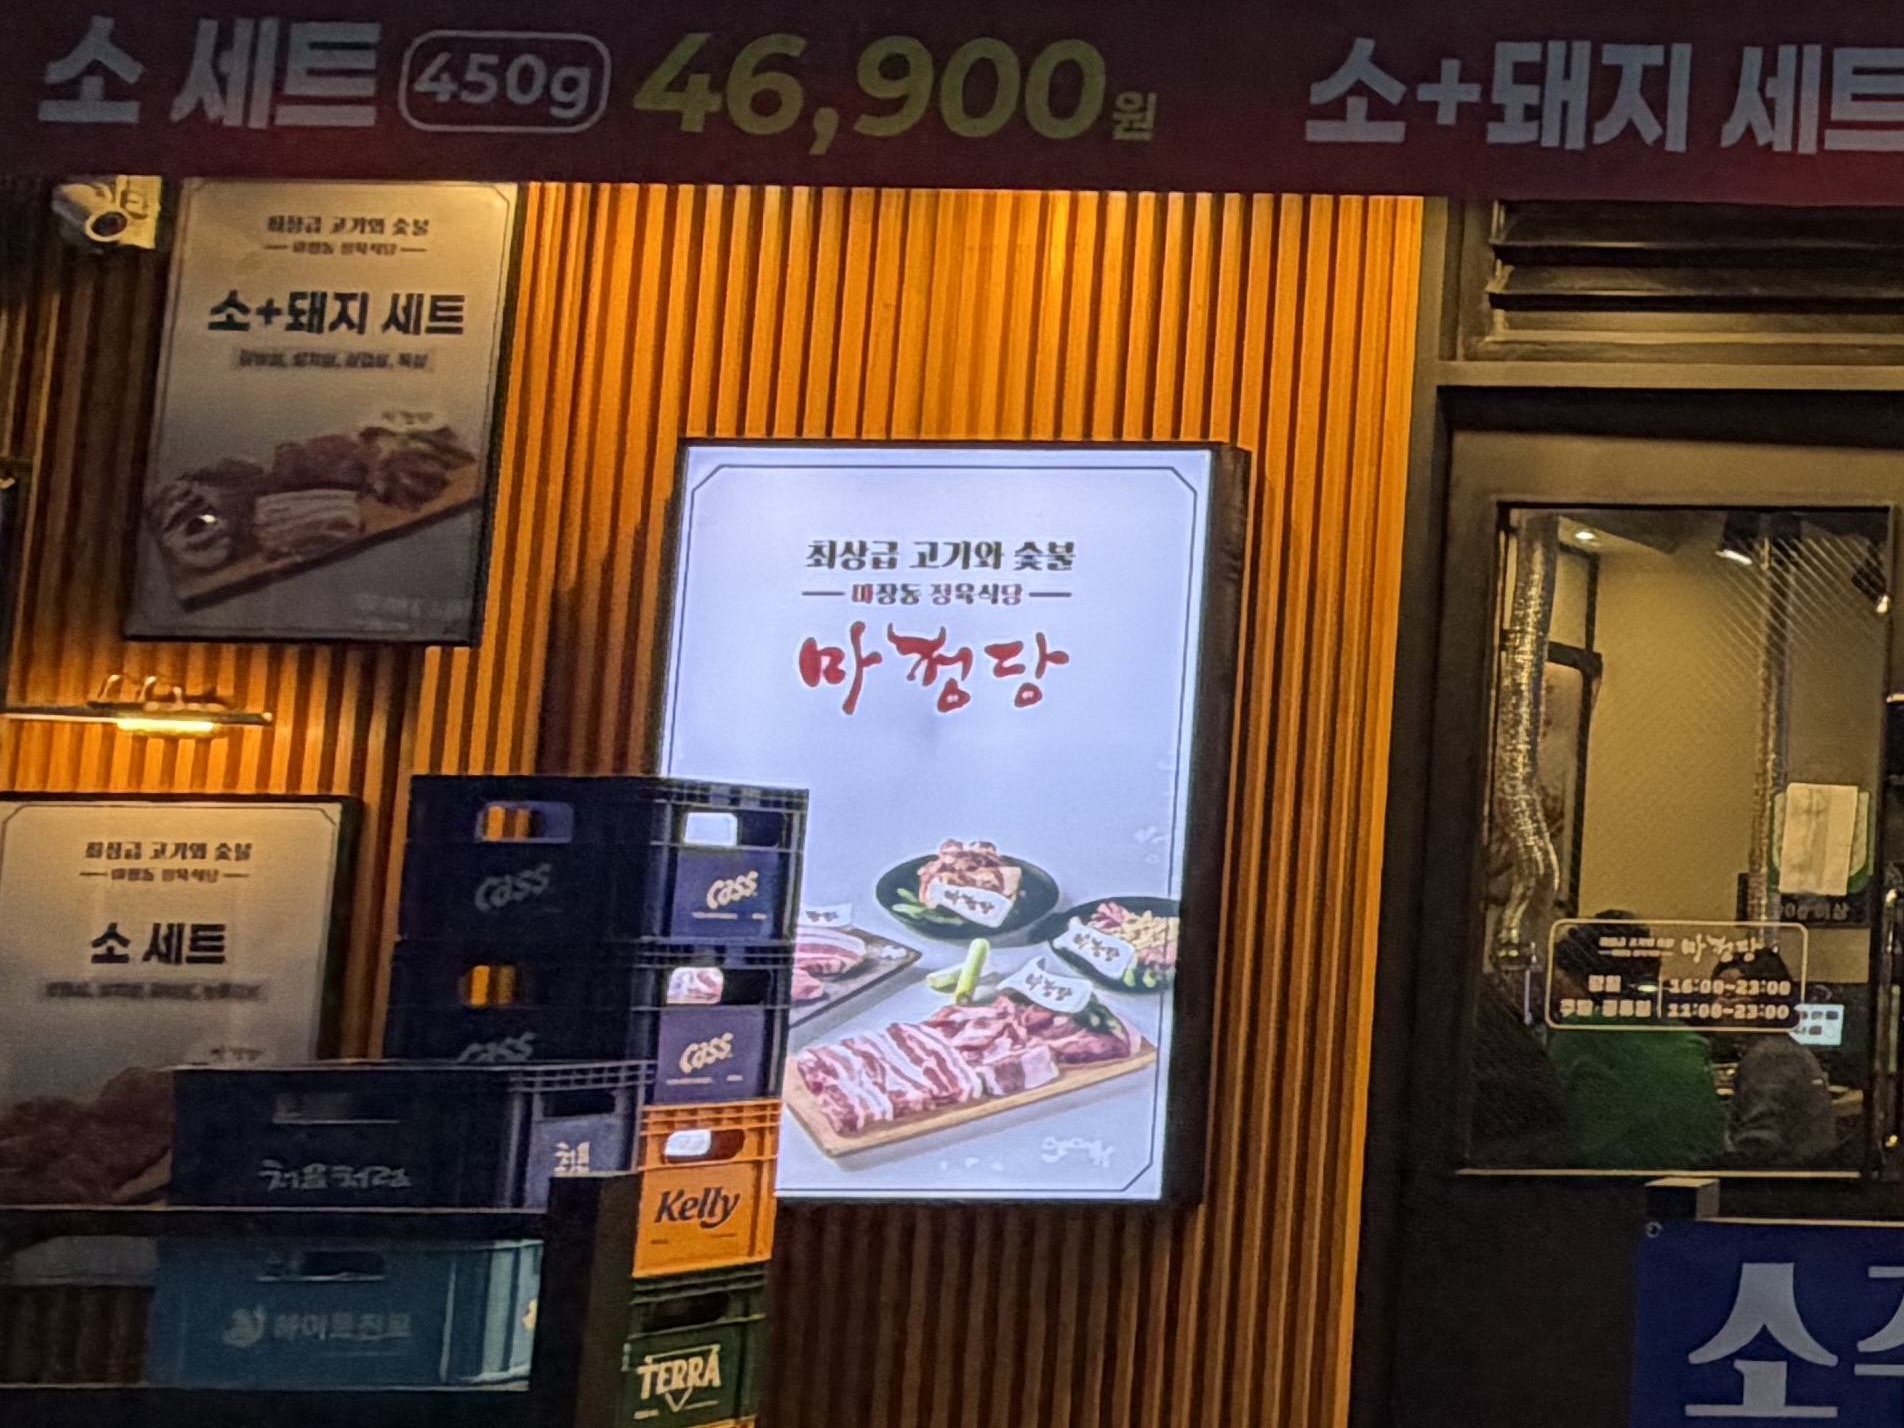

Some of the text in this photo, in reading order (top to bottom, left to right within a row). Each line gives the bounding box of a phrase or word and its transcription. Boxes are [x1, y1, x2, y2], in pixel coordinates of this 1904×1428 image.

[38, 15, 145, 125] 소
[173, 15, 381, 130] 세트
[413, 50, 593, 128] 450g
[1306, 37, 1690, 154] 소+돼지
[208, 289, 465, 335] 소+돼지 세트
[805, 539, 1076, 572] 최상급 고기와 숯불
[799, 621, 1070, 715] 마정당
[706, 871, 759, 909] Cass
[91, 922, 226, 965] 소 세트
[680, 1032, 734, 1073] Cass
[261, 1159, 411, 1192] 처음처럼
[655, 1186, 741, 1228] Kelly
[636, 1345, 722, 1400] TERRA
